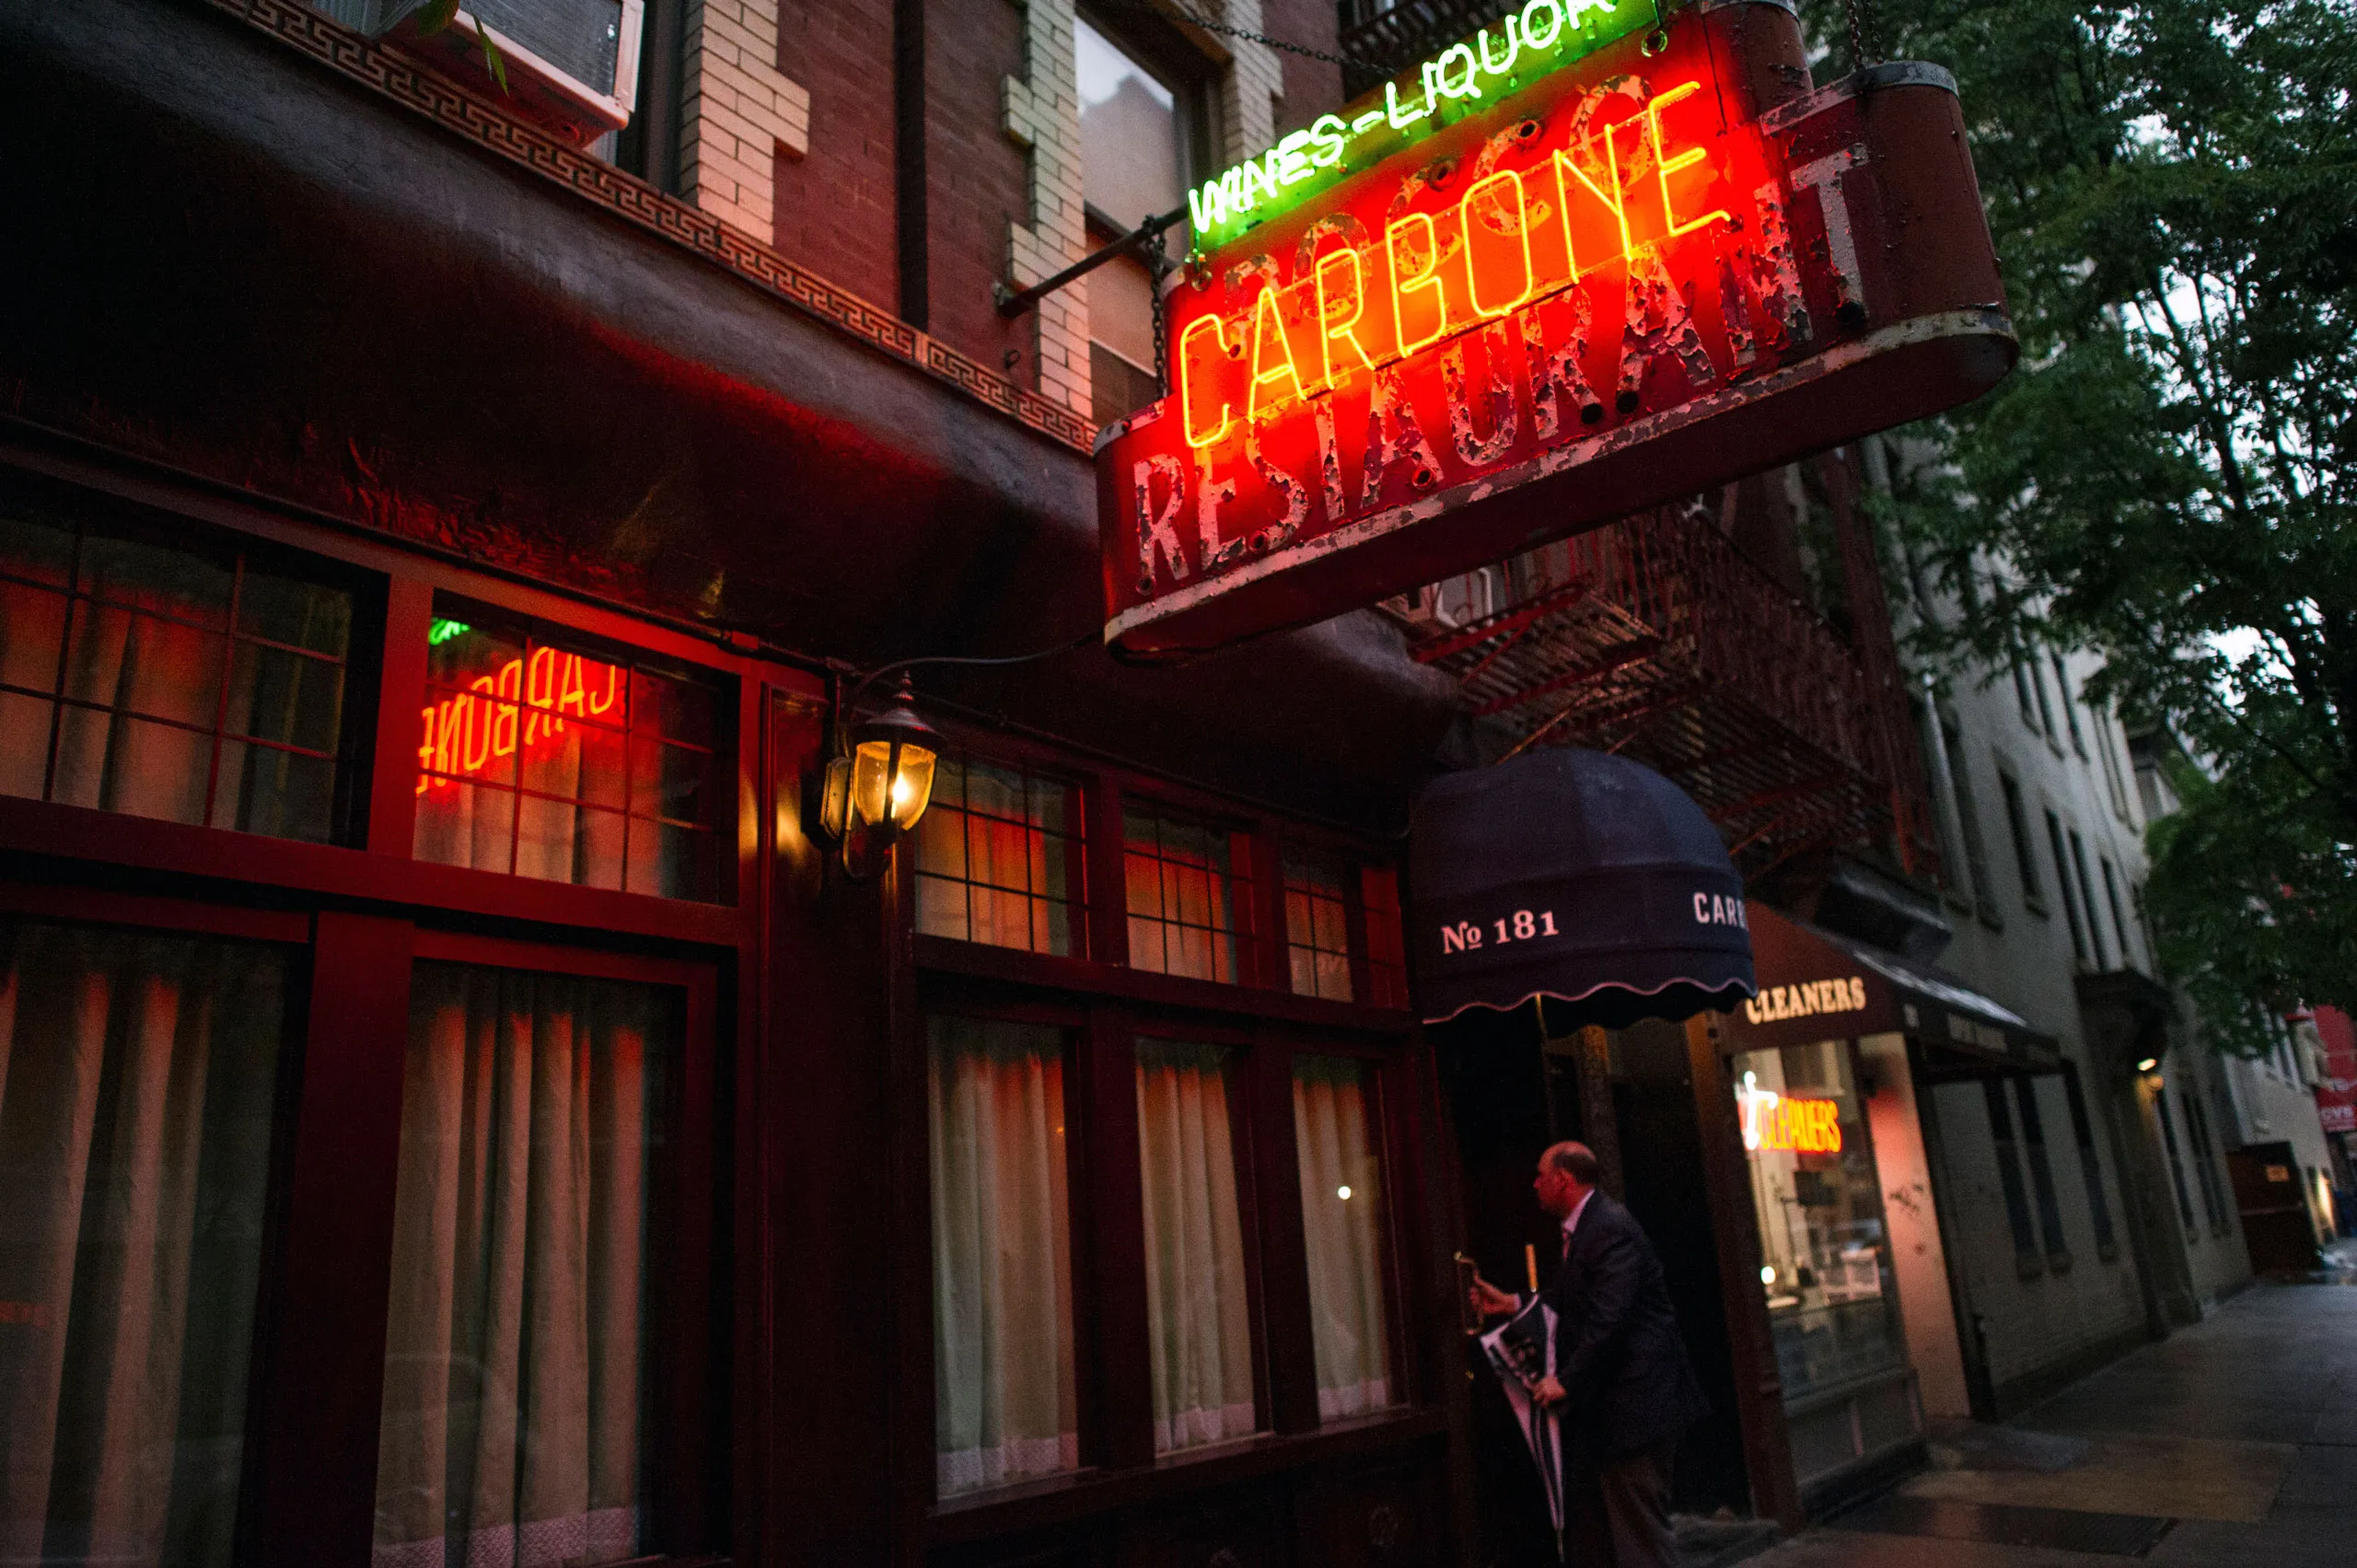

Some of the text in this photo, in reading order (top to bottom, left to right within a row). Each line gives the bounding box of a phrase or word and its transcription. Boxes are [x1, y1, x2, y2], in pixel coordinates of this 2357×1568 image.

[1132, 142, 1871, 595] RESTAURANT
[1179, 79, 1732, 449] CARBONE
[1493, 910, 1560, 944] 181
[1746, 976, 1866, 1025] CLEANERS
